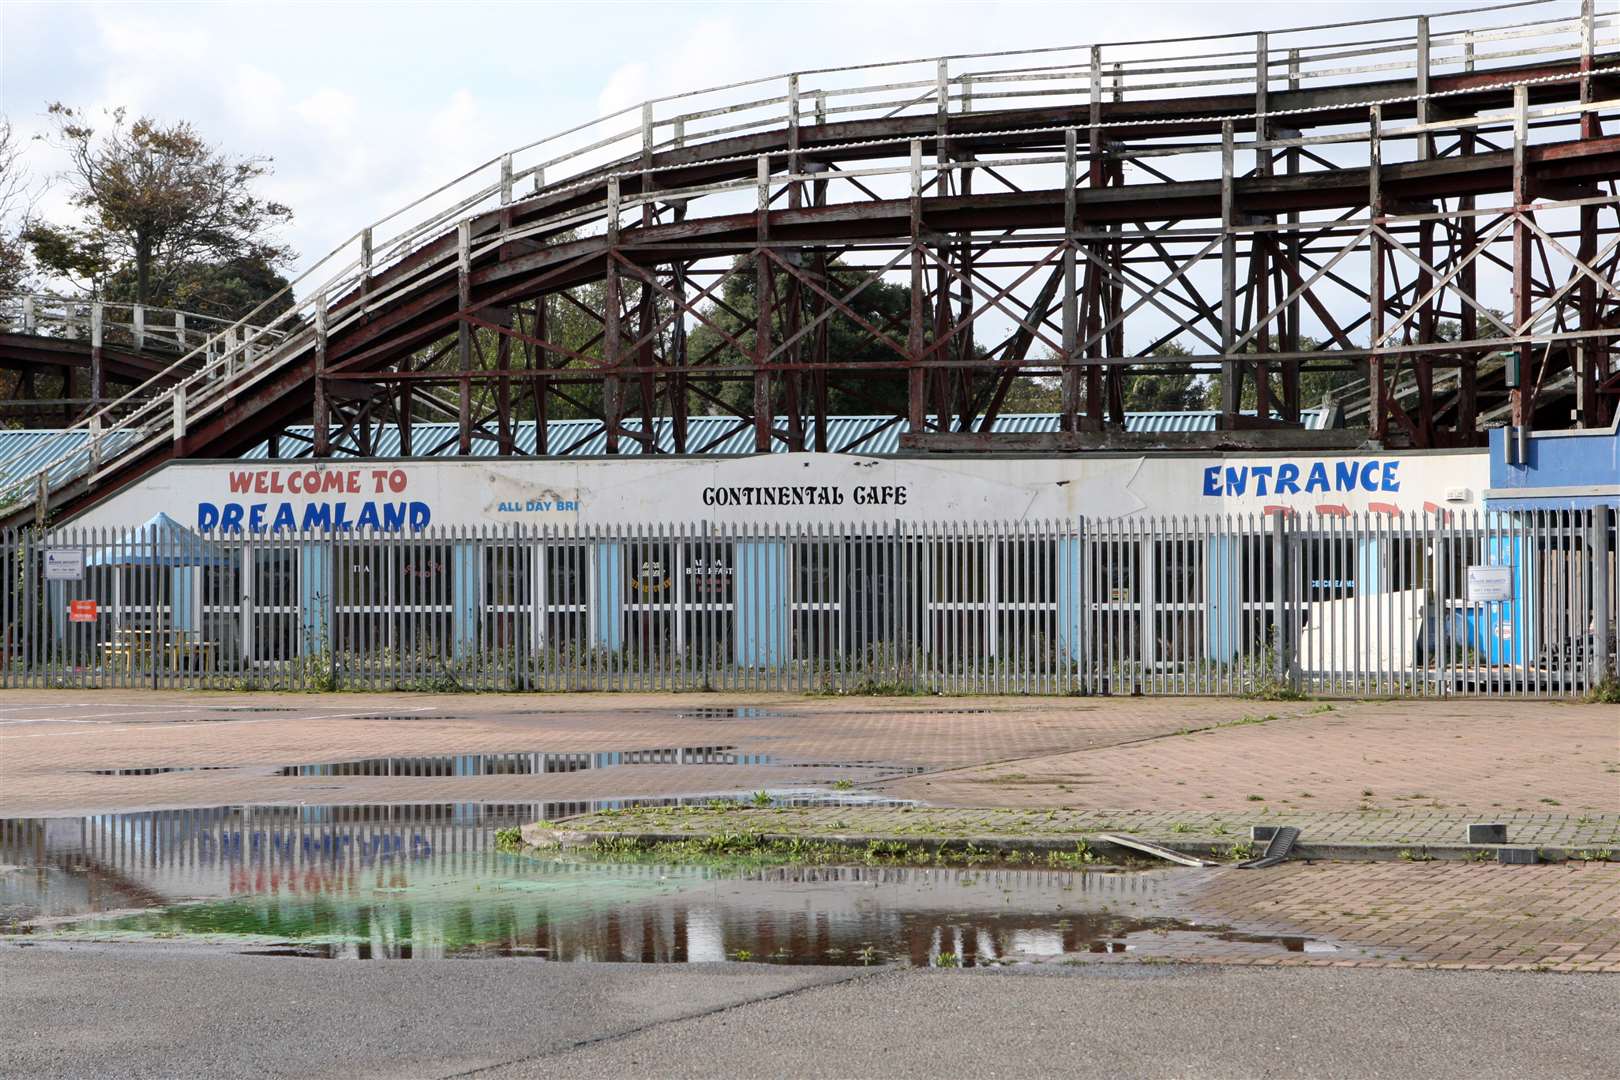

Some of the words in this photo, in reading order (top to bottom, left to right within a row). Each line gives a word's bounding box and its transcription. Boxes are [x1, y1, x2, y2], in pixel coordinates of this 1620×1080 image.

[229, 470, 362, 494] WELCOME
[372, 469, 408, 494] TO
[1203, 460, 1400, 497] ENTRANCE
[498, 502, 522, 512] ALL
[526, 501, 551, 512] DAY
[702, 486, 844, 506] CONTINENTAL
[853, 486, 908, 505] CAFE
[197, 501, 431, 535] DREAMLAND
